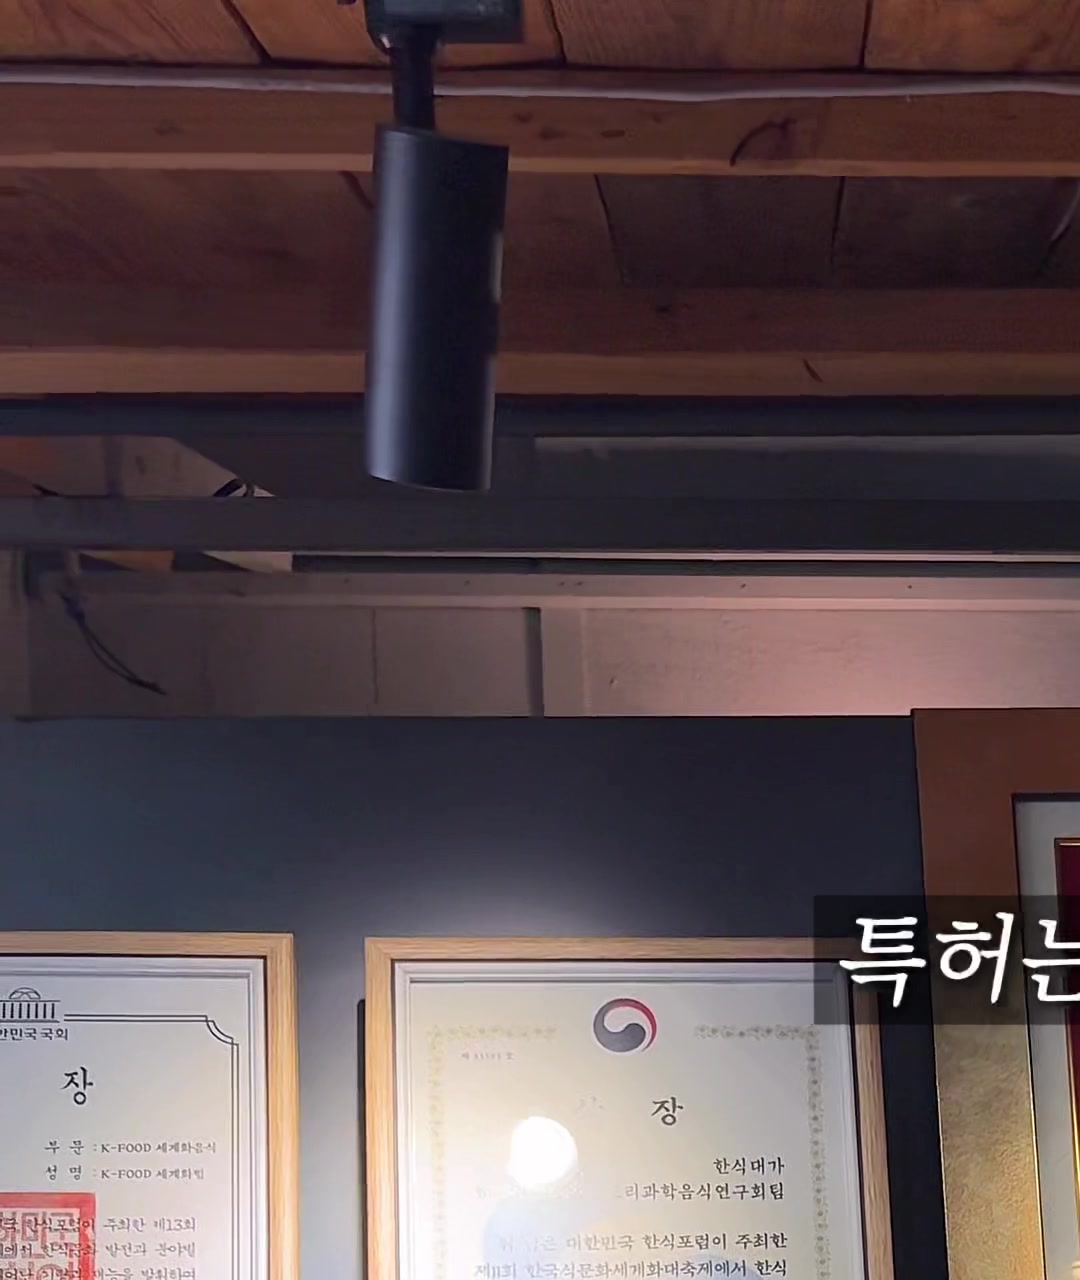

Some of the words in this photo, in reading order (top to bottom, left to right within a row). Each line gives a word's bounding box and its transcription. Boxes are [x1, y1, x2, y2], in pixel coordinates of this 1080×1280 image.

[62, 1066, 93, 1105] 장
[651, 1097, 684, 1126] 장
[713, 1157, 785, 1175] 한식대가
[617, 1182, 786, 1201] 리과학음식연구회팀
[643, 1232, 727, 1251] 한식포럼이
[735, 1232, 787, 1250] 주최한
[754, 1259, 787, 1278] 한식
